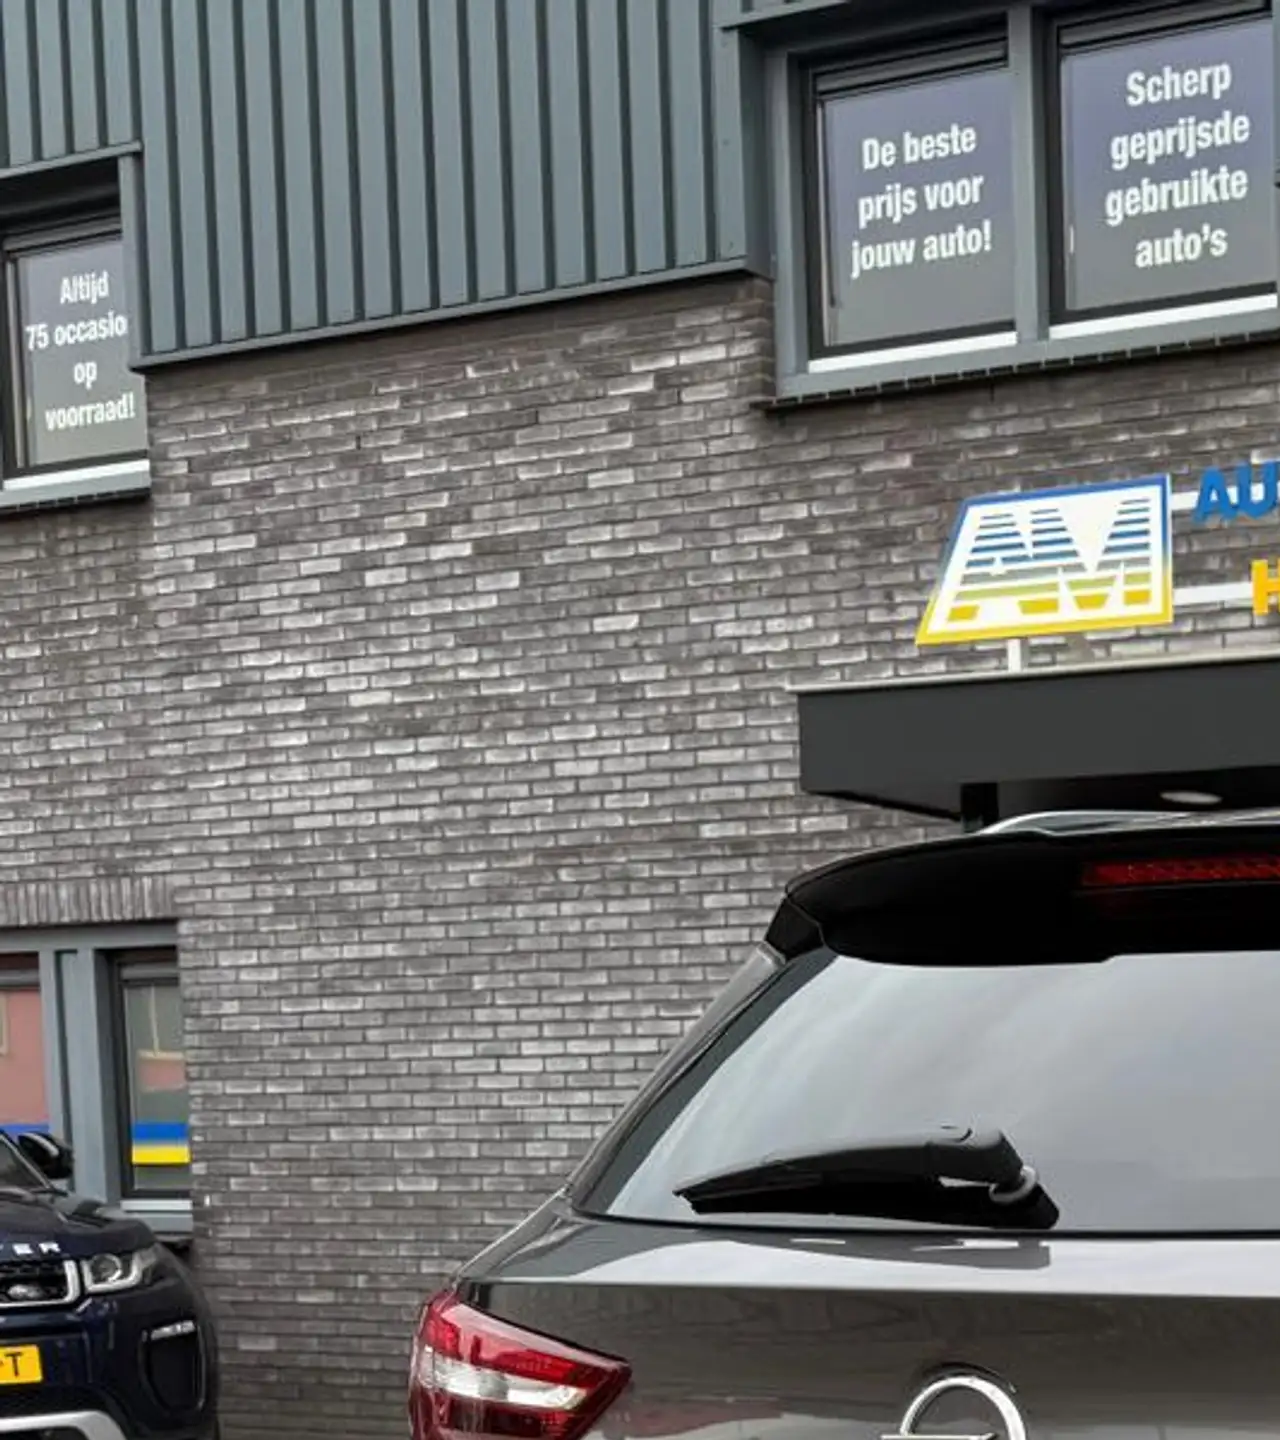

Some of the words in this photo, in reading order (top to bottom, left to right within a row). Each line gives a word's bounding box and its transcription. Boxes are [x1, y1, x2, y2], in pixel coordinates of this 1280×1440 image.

[1126, 63, 1232, 106] Scherp
[862, 137, 896, 169] De
[903, 123, 977, 165] beste
[1110, 112, 1250, 169] geprijsde
[857, 184, 917, 229] prijs
[924, 178, 984, 211] voor
[1105, 166, 1248, 226] gebruikte
[851, 234, 915, 278] jouw
[923, 219, 992, 260] auto!
[1135, 225, 1228, 268] auto's
[60, 270, 109, 304] Altijd
[26, 324, 49, 351] 75
[73, 361, 97, 390] op
[45, 392, 136, 431] voorraad!
